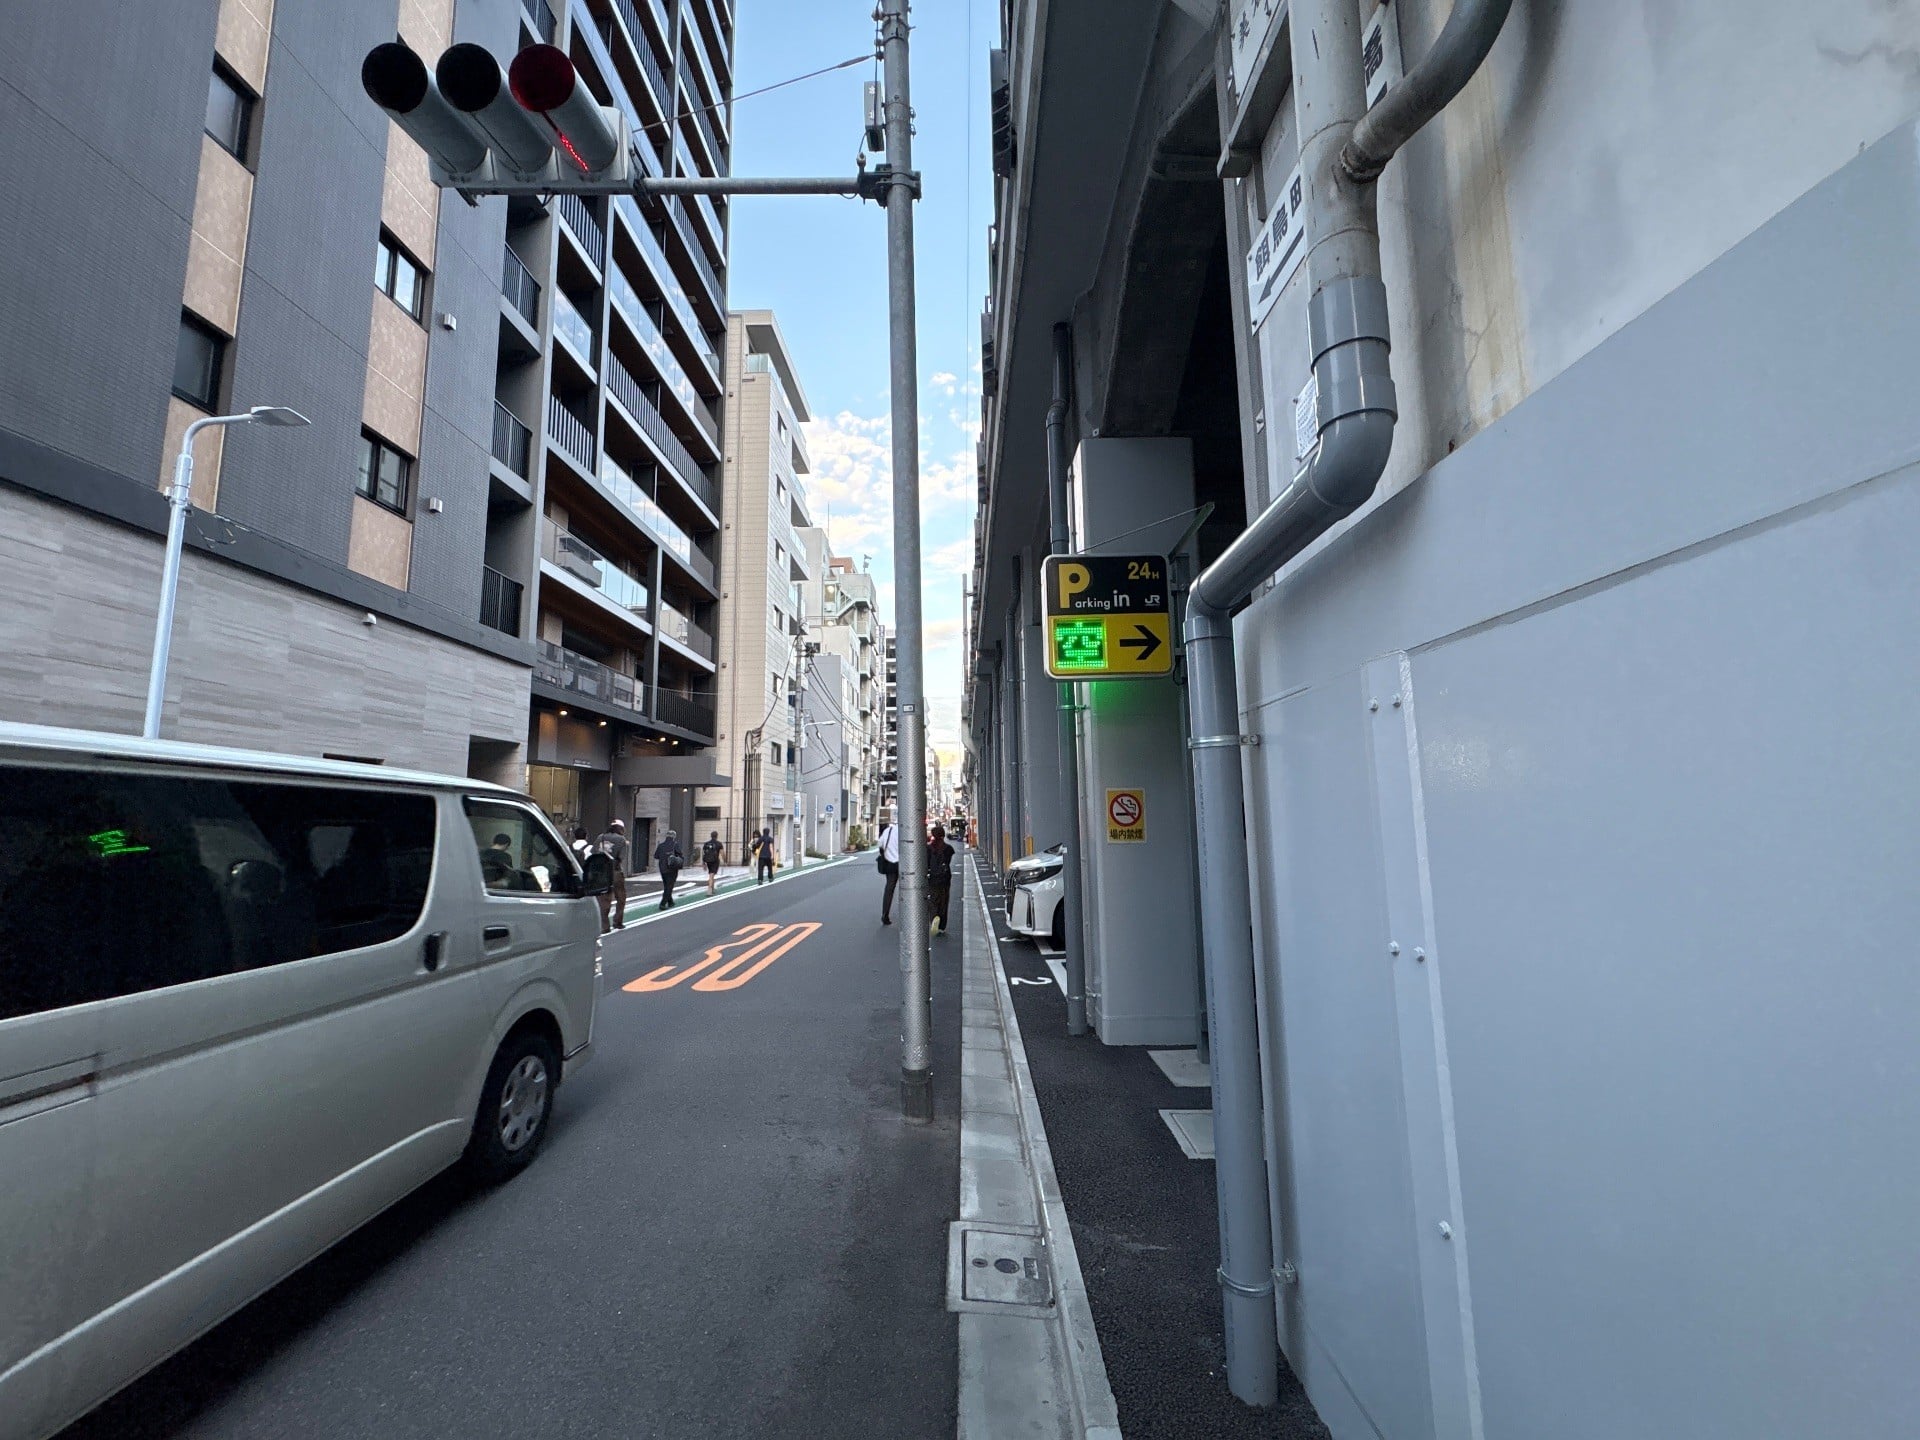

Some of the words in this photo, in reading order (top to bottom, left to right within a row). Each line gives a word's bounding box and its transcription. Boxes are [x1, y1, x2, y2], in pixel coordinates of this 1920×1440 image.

[1128, 562, 1160, 580] 24H
[1112, 589, 1131, 607] in
[1144, 594, 1161, 605] JR
[621, 922, 824, 993] 30
